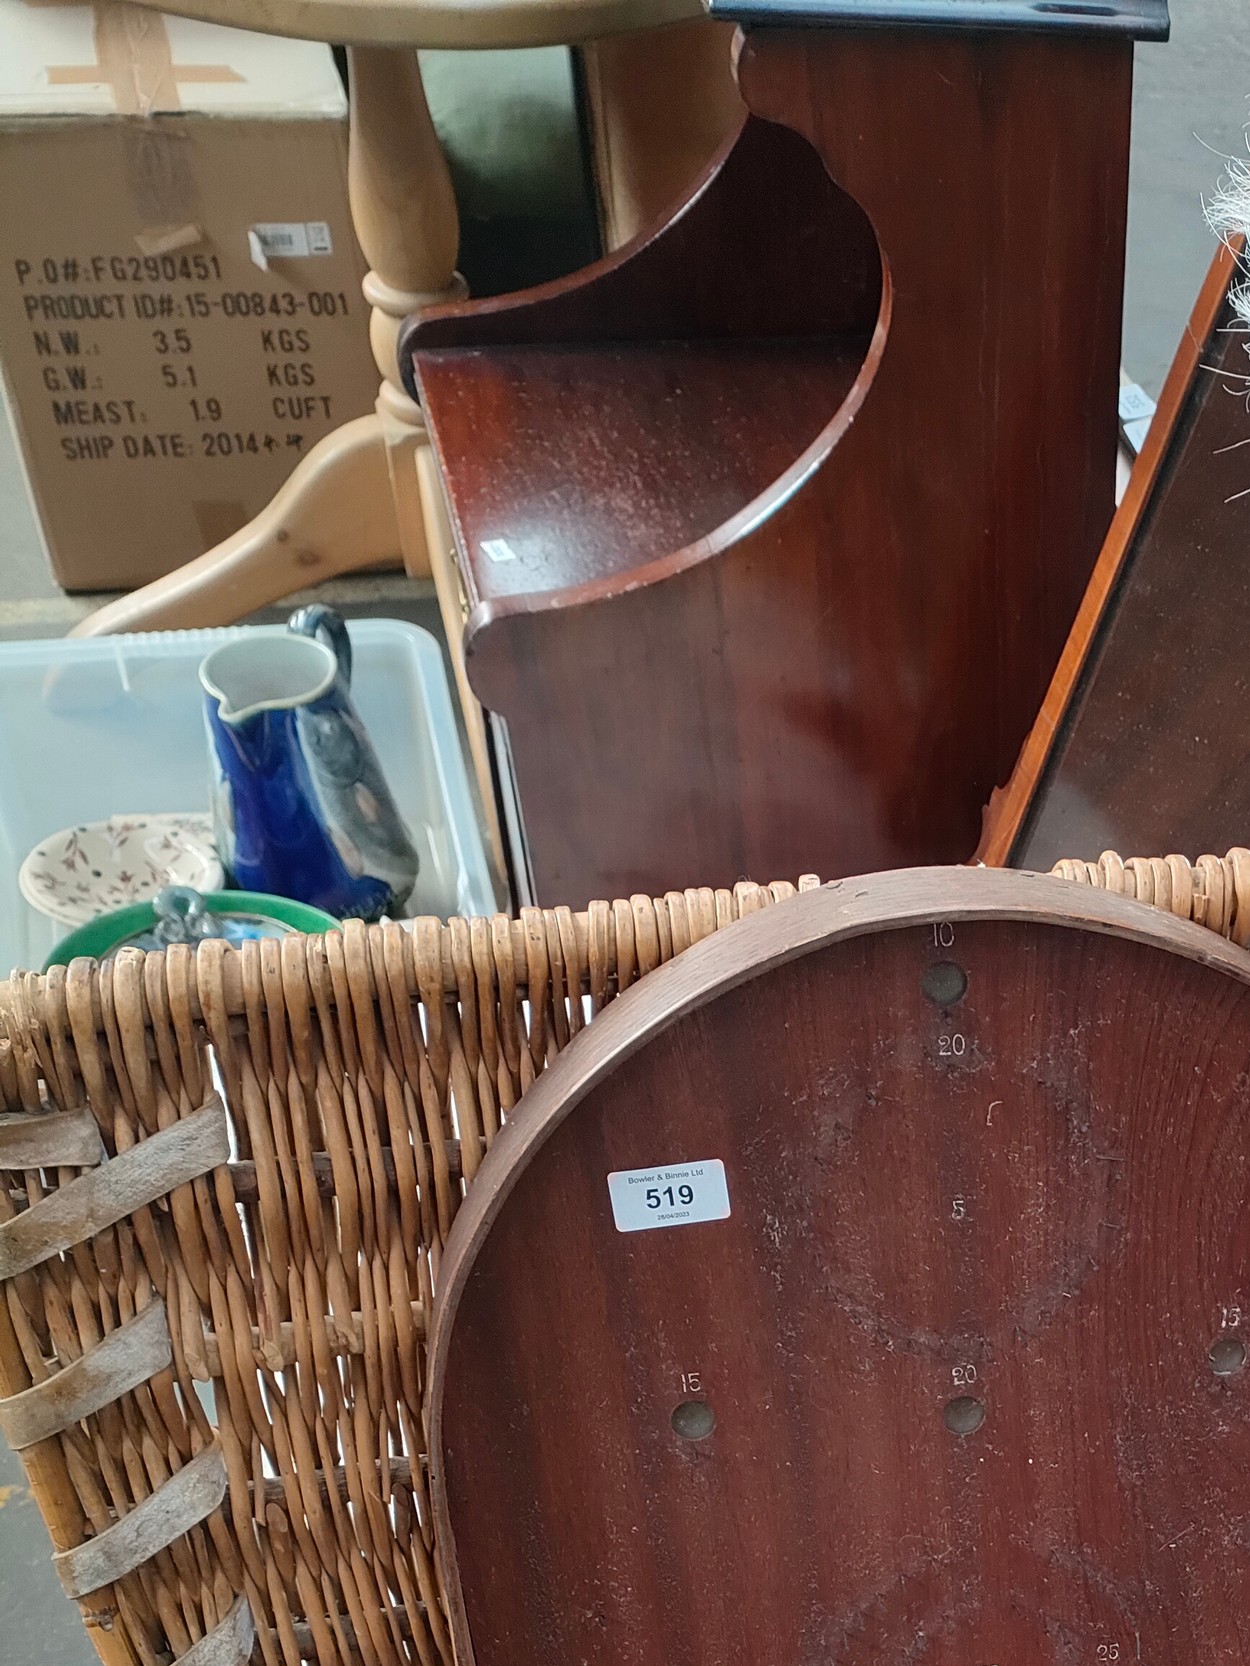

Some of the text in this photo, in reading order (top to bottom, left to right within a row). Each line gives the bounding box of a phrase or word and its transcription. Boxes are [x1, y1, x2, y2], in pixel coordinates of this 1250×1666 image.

[22, 294, 125, 321] PRODUCT
[152, 328, 192, 353] 3.5
[260, 329, 312, 353] KGS
[161, 365, 198, 389] 5.1
[265, 363, 316, 386] KGS
[190, 398, 223, 422] 1.9
[272, 396, 332, 421] CUFT
[61, 436, 114, 461] SHIP
[123, 434, 195, 458] DATE:
[201, 431, 259, 456] 2014
[933, 922, 955, 947] 10
[938, 1033, 966, 1056] 20
[628, 1176, 654, 1184] Bowler
[691, 1168, 704, 1176] Ltd
[646, 1184, 694, 1209] 519
[657, 1211, 690, 1220] 28/04/2023
[951, 1200, 964, 1220] 5
[1221, 1306, 1241, 1328] 15
[681, 1372, 701, 1392] 15
[952, 1365, 977, 1385] 20
[1096, 1642, 1119, 1662] 25
